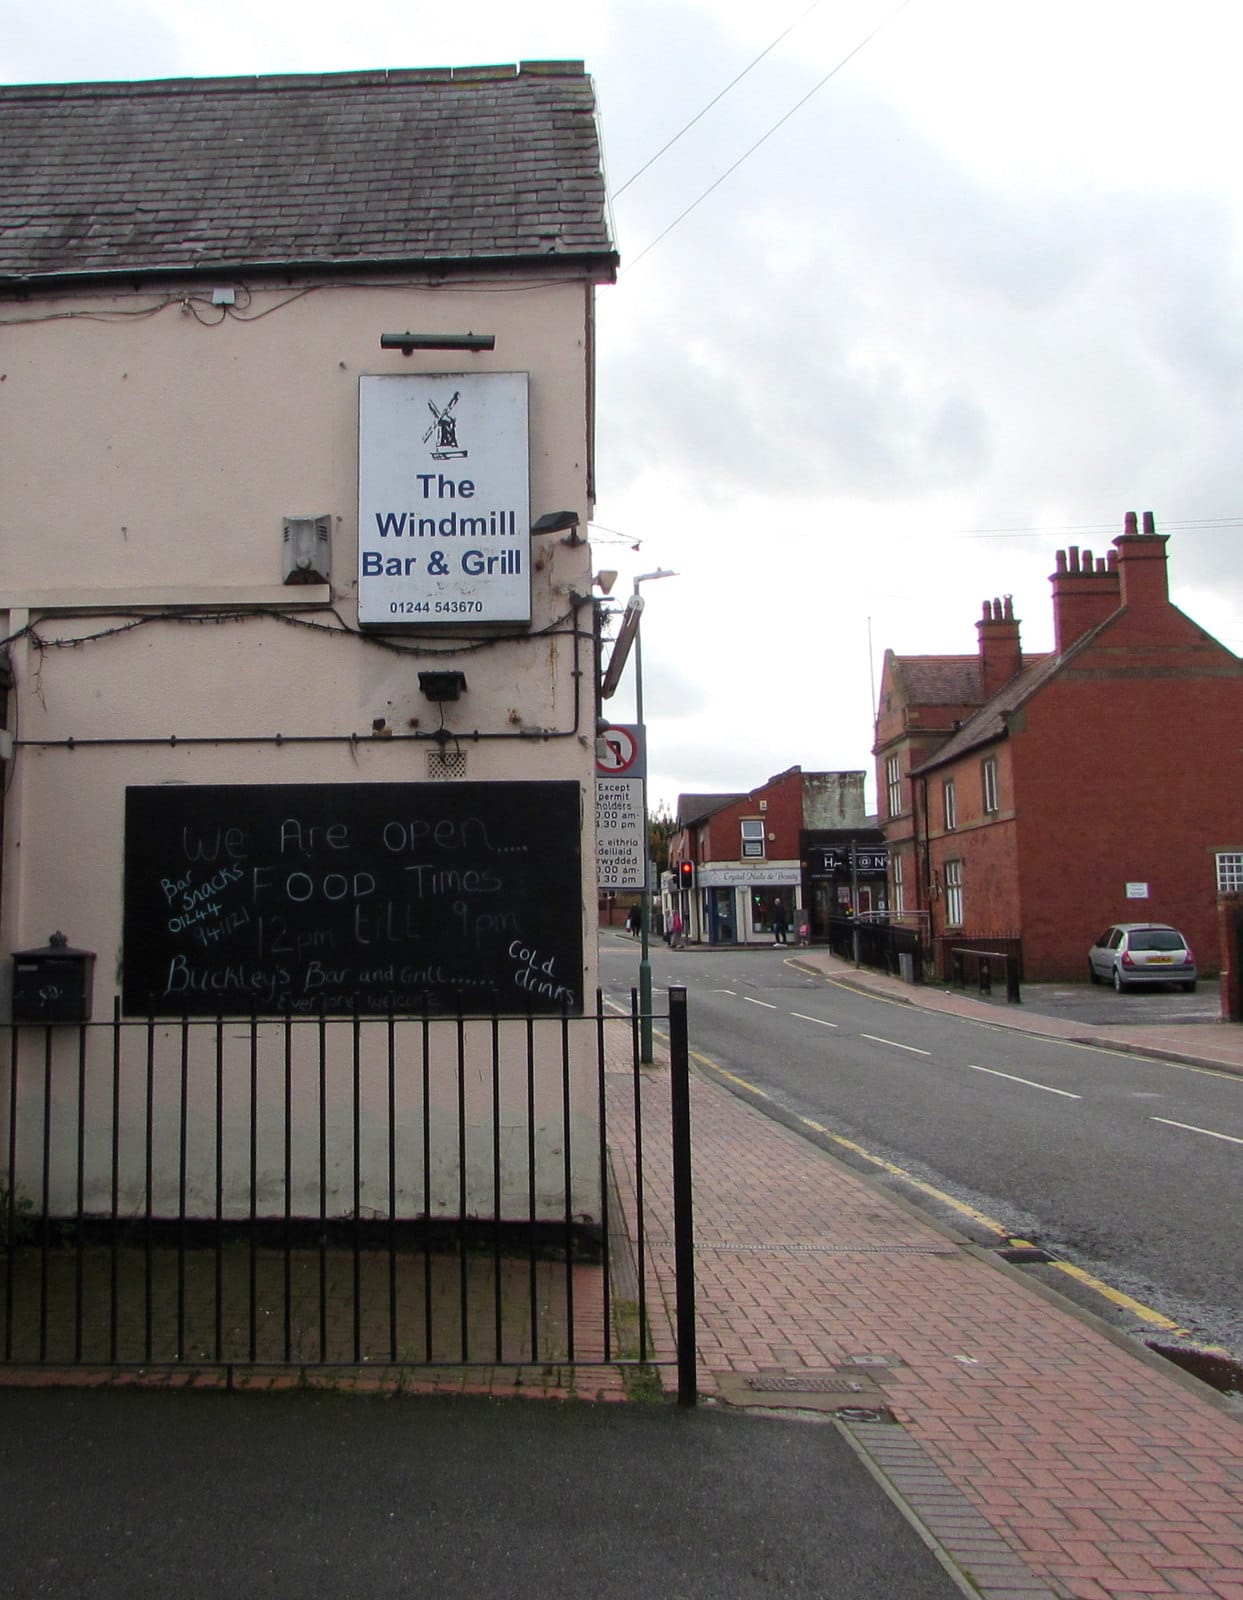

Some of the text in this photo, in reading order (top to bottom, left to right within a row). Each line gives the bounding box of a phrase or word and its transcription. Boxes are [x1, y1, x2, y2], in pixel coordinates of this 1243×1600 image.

[416, 474, 475, 499] The
[375, 511, 516, 537] Windmill
[362, 550, 521, 577] Bar & Grill
[390, 601, 483, 613] 01244 543670
[598, 784, 630, 792] Except
[598, 793, 629, 801] permit
[596, 801, 631, 810] holders
[183, 825, 249, 862] We
[281, 818, 351, 853] Are
[598, 847, 632, 856] deiliaid
[607, 838, 639, 846] eithrio
[160, 870, 192, 904] Bar
[168, 902, 223, 933] 01244
[303, 960, 351, 993] Bar
[359, 965, 394, 983] and
